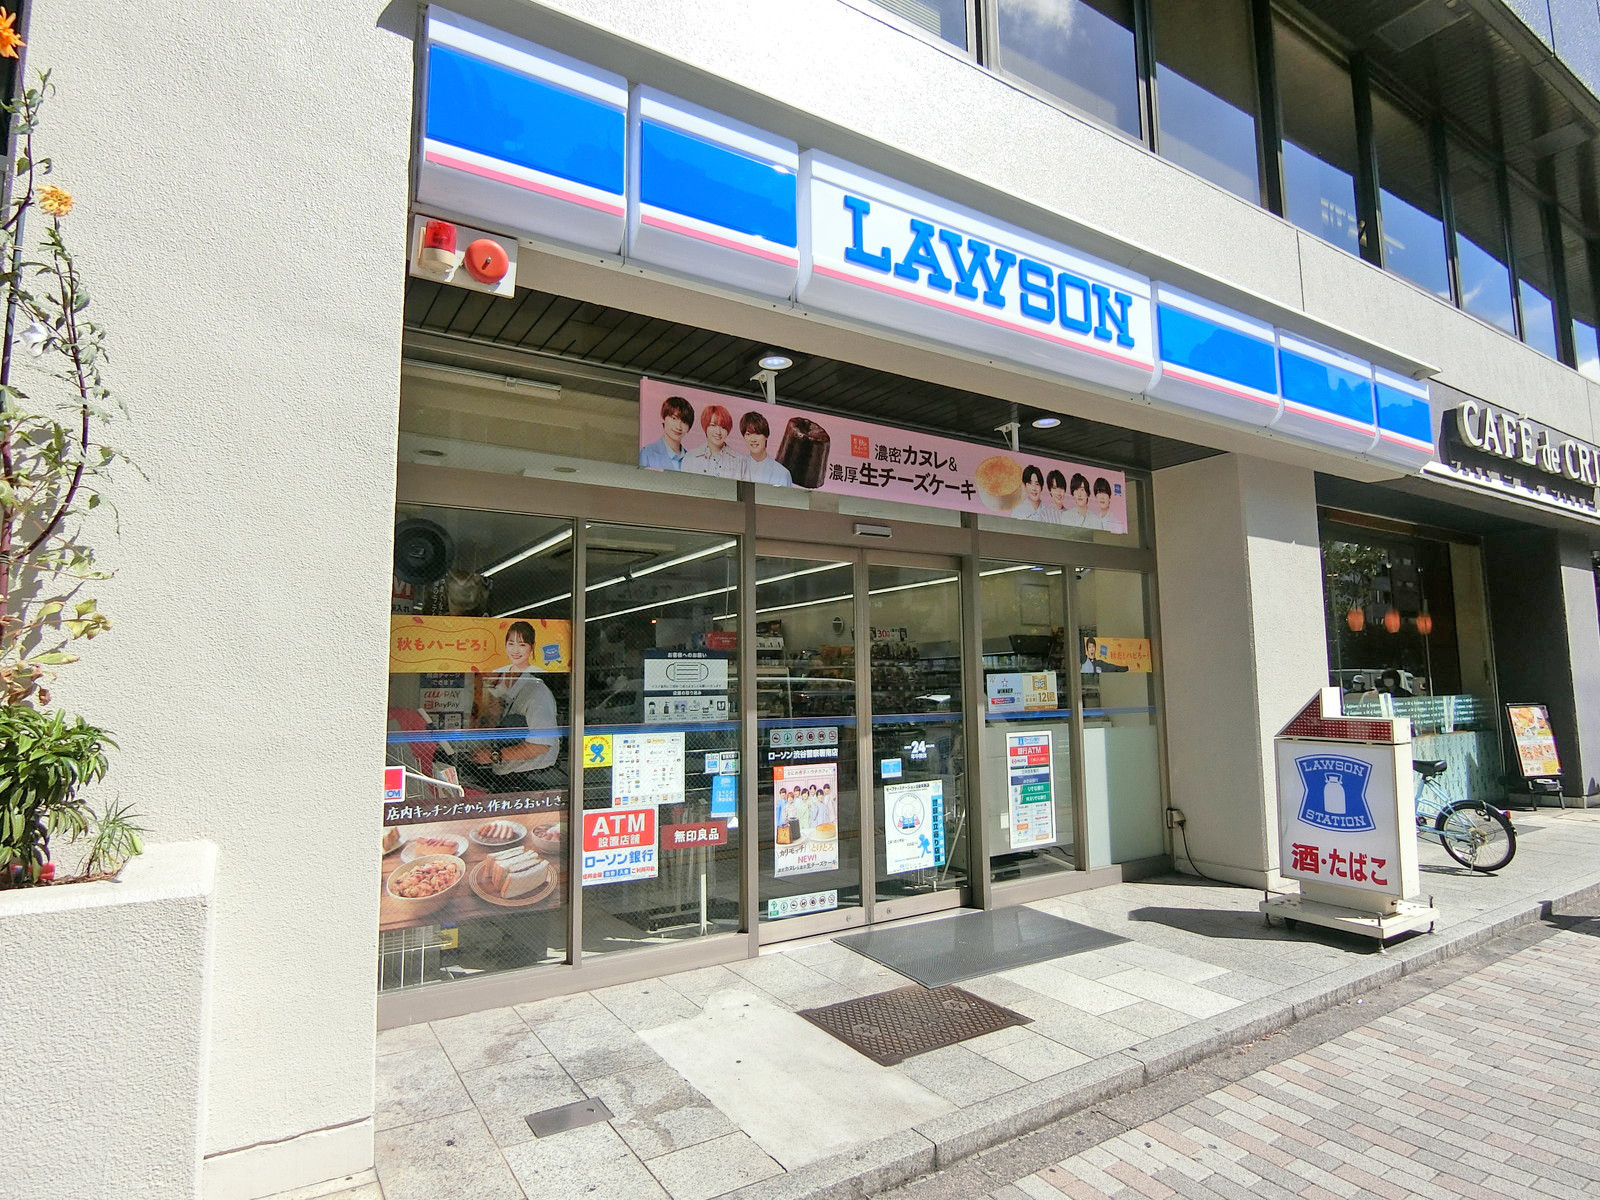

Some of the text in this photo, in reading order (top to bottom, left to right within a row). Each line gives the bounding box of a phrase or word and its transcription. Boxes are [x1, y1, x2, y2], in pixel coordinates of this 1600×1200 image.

[843, 195, 1135, 349] LAWSON
[1456, 400, 1536, 466] CAFÉ
[1538, 430, 1561, 473] de
[874, 444, 957, 472] 濃密カヌレ&
[828, 462, 976, 500] 濃厚生チーズケーキ
[397, 637, 487, 651] 秋もハーピろ!
[911, 740, 926, 753] 24
[1302, 760, 1364, 776] LAWSON
[592, 813, 645, 836] ATM
[1306, 809, 1367, 827] STATION
[598, 834, 640, 847] 設置店舗
[674, 827, 719, 843] 無印良品
[585, 849, 653, 868] ローソン銀行
[798, 855, 817, 863] NEW!
[1291, 842, 1388, 886] 酒・たばこ
